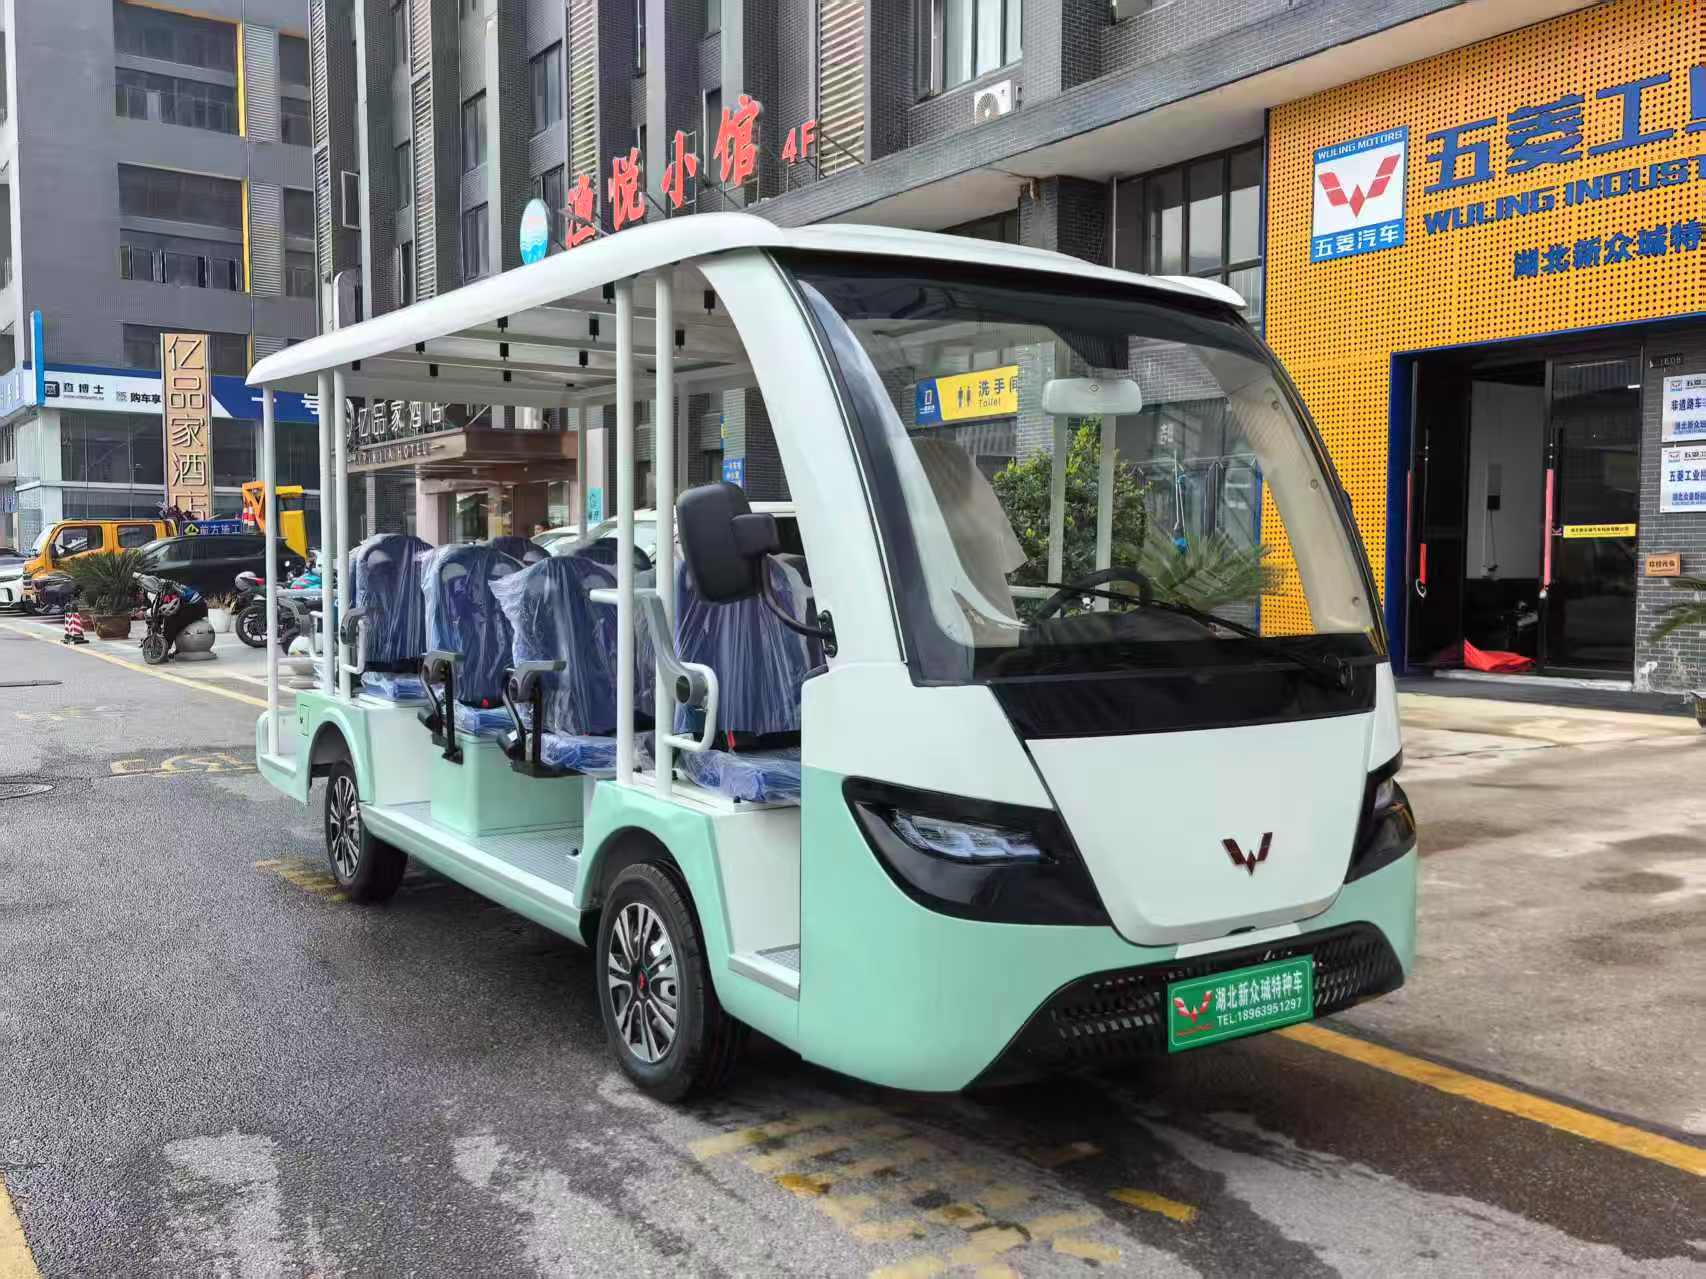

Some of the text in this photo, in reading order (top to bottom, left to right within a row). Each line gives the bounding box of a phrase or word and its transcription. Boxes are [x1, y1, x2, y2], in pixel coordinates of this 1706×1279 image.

[781, 119, 817, 162] 4F
[1318, 129, 1403, 160] WULING MOTORS
[1423, 65, 1706, 194] 五菱工
[1424, 186, 1557, 236] WULING
[1315, 223, 1400, 258] 五菱汽车
